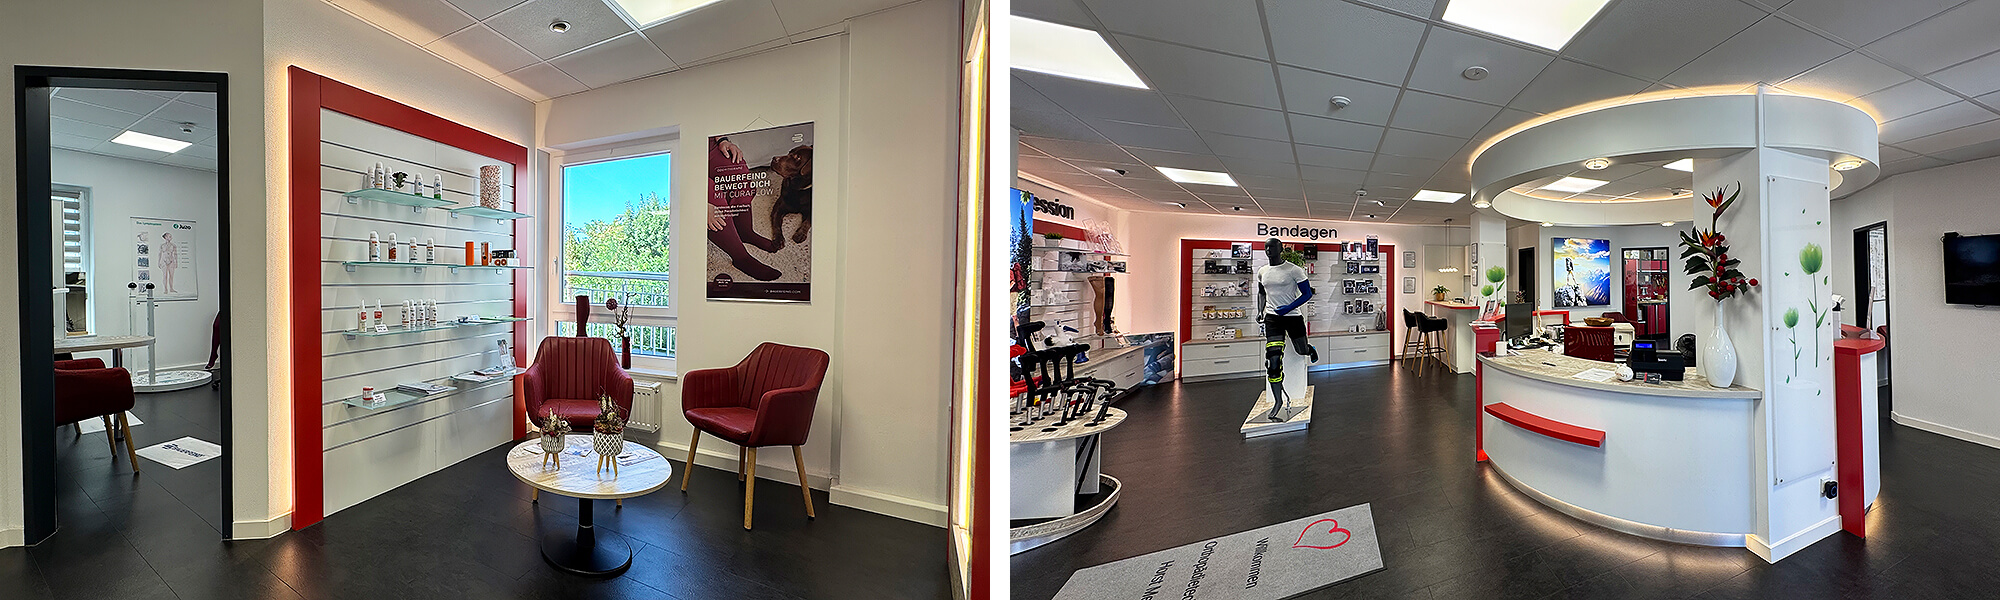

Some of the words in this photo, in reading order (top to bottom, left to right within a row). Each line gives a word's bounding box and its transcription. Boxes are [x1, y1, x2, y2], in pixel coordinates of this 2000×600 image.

[714, 172, 767, 183] BAUERFEIND
[714, 181, 748, 191] BEWEGT
[750, 180, 770, 189] DICH
[714, 191, 727, 199] MIT
[729, 188, 773, 198] CURAFLOW
[1257, 223, 1338, 241] Bandagen
[1245, 536, 1269, 590] Willkommen
[1148, 559, 1175, 587] Horst
